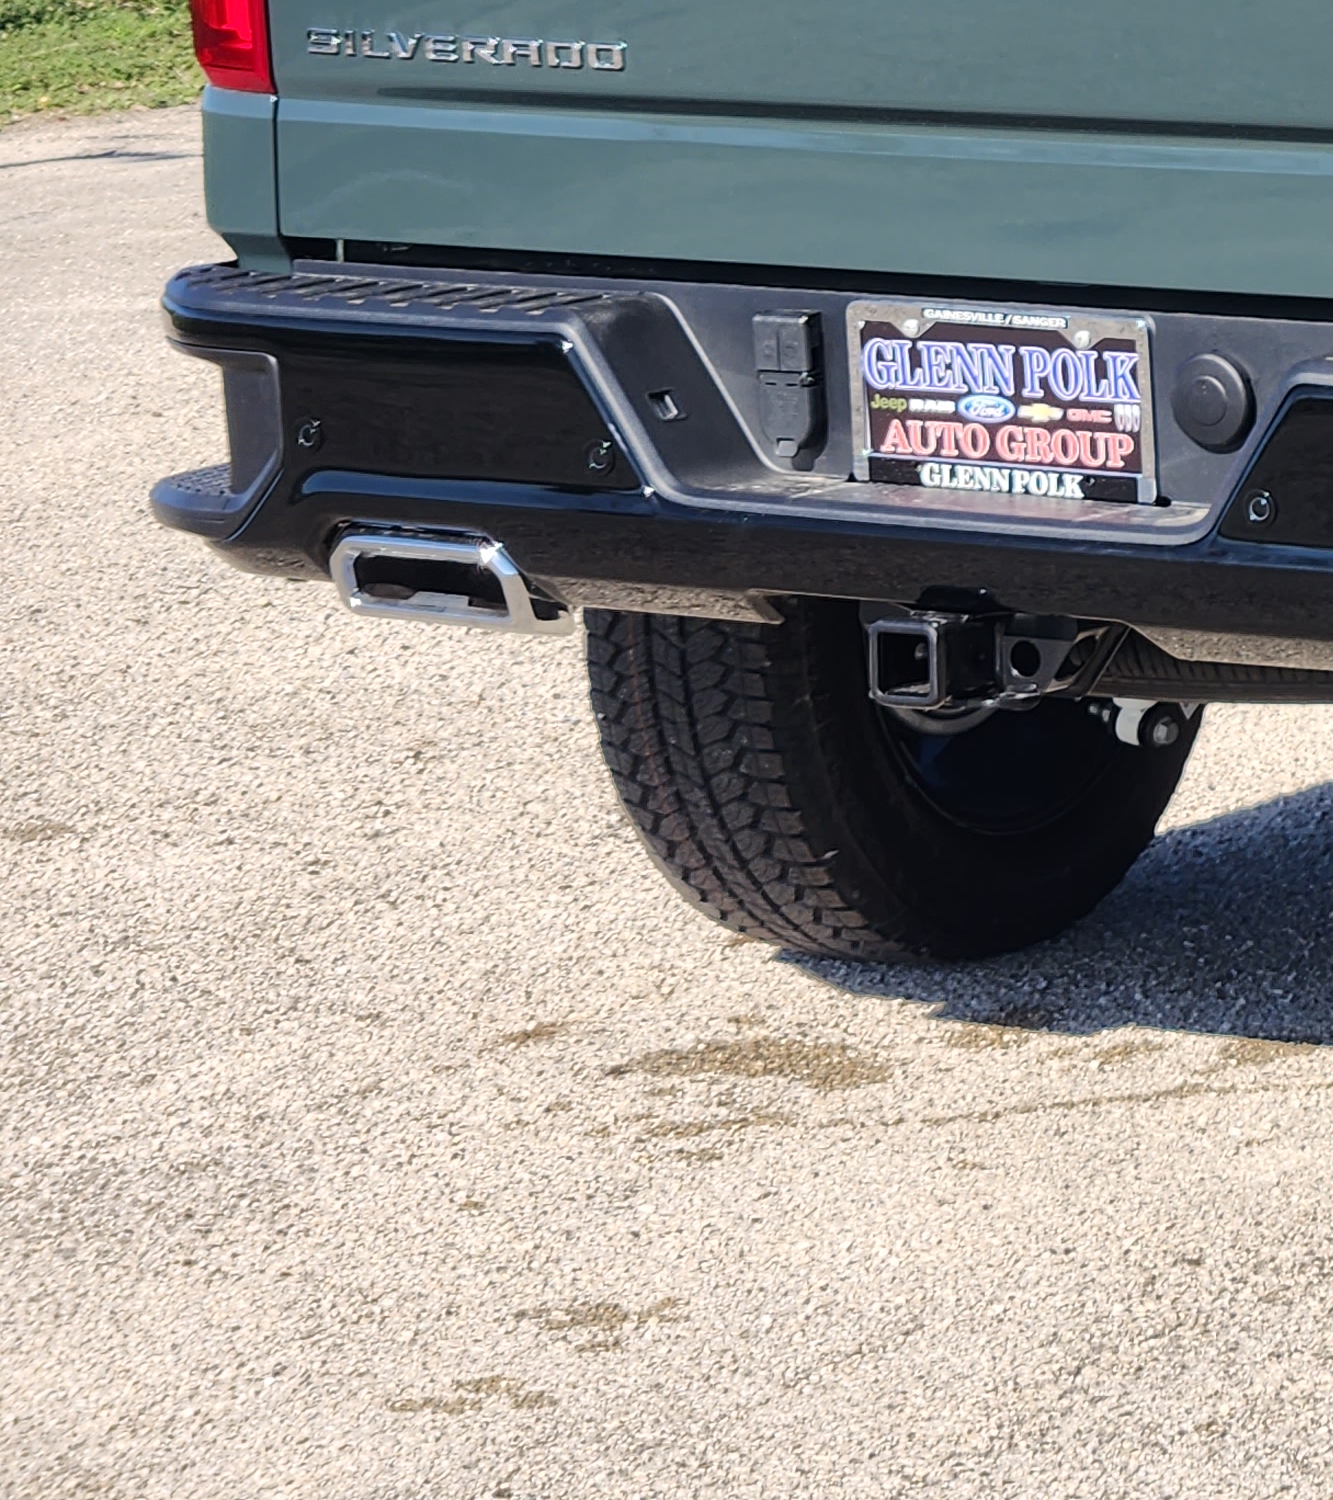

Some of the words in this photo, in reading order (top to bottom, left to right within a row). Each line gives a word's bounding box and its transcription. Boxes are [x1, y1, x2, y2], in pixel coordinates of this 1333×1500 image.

[306, 27, 628, 72] SILVERADO
[863, 337, 1016, 396] GLENN
[1021, 346, 1141, 403] POLK
[870, 393, 907, 413] Jeep
[968, 400, 1006, 418] Ford
[1066, 408, 1113, 423] GMC
[881, 418, 991, 457] AUTO
[996, 425, 1134, 468] GROUP
[919, 462, 1009, 494] GLENN
[1011, 469, 1085, 499] POLK
